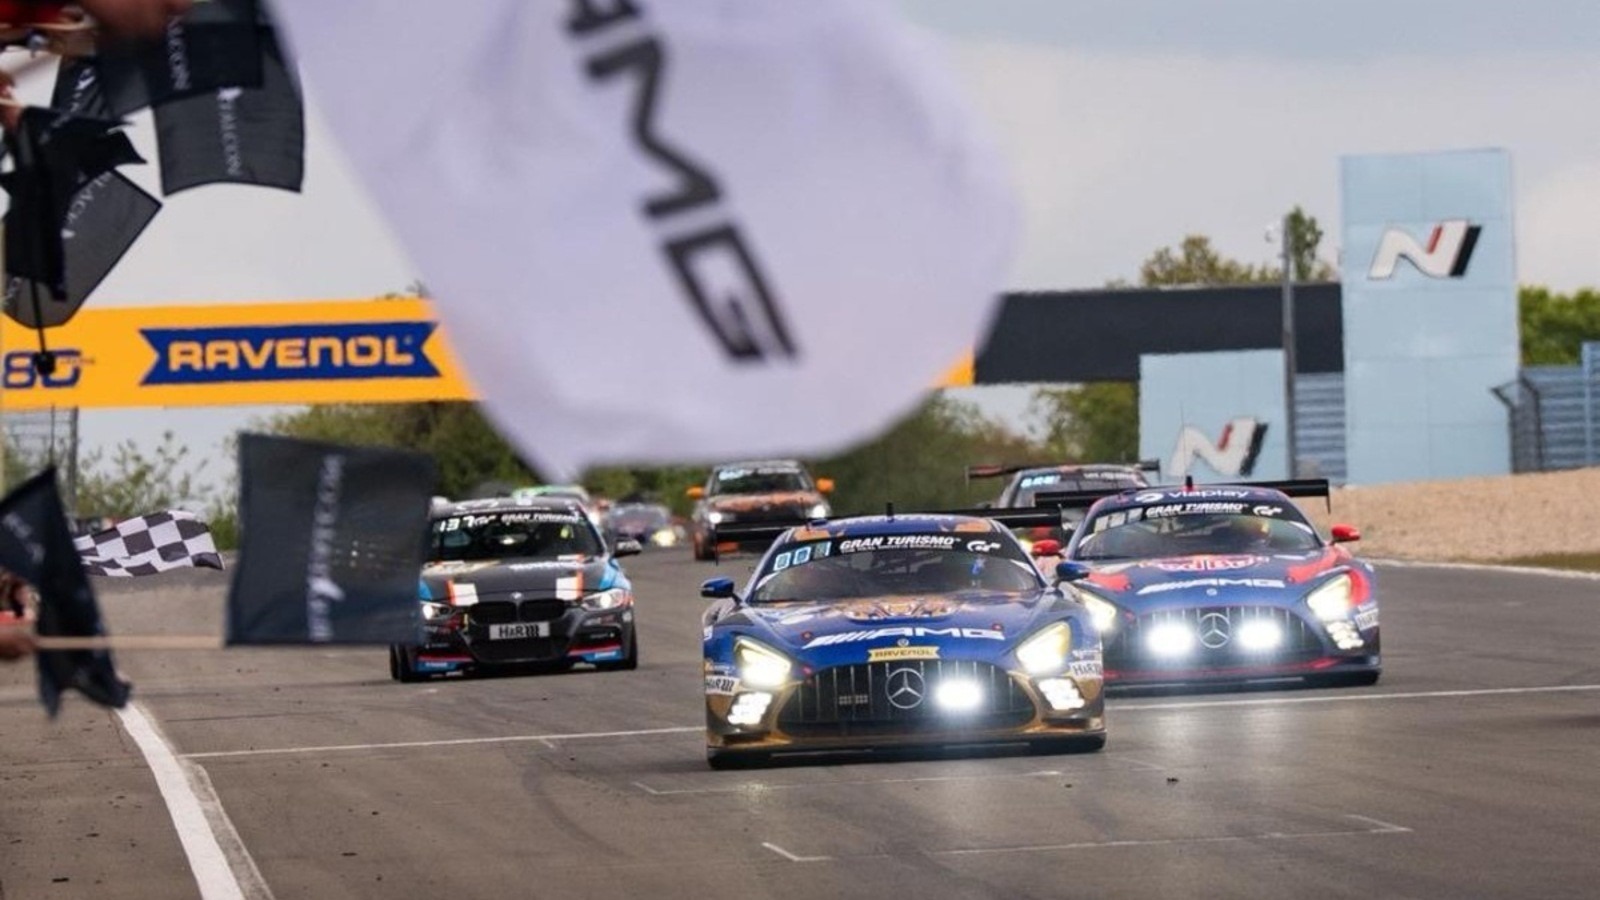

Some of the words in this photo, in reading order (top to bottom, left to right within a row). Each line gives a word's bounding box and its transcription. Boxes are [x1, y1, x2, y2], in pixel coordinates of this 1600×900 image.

[168, 335, 414, 372] RAVENOL
[1146, 503, 1183, 515] GRAN
[1186, 502, 1243, 512] TURISMO
[840, 537, 884, 549] GRAN
[887, 535, 954, 545] TURISMO
[874, 648, 934, 658] RAVENOL
